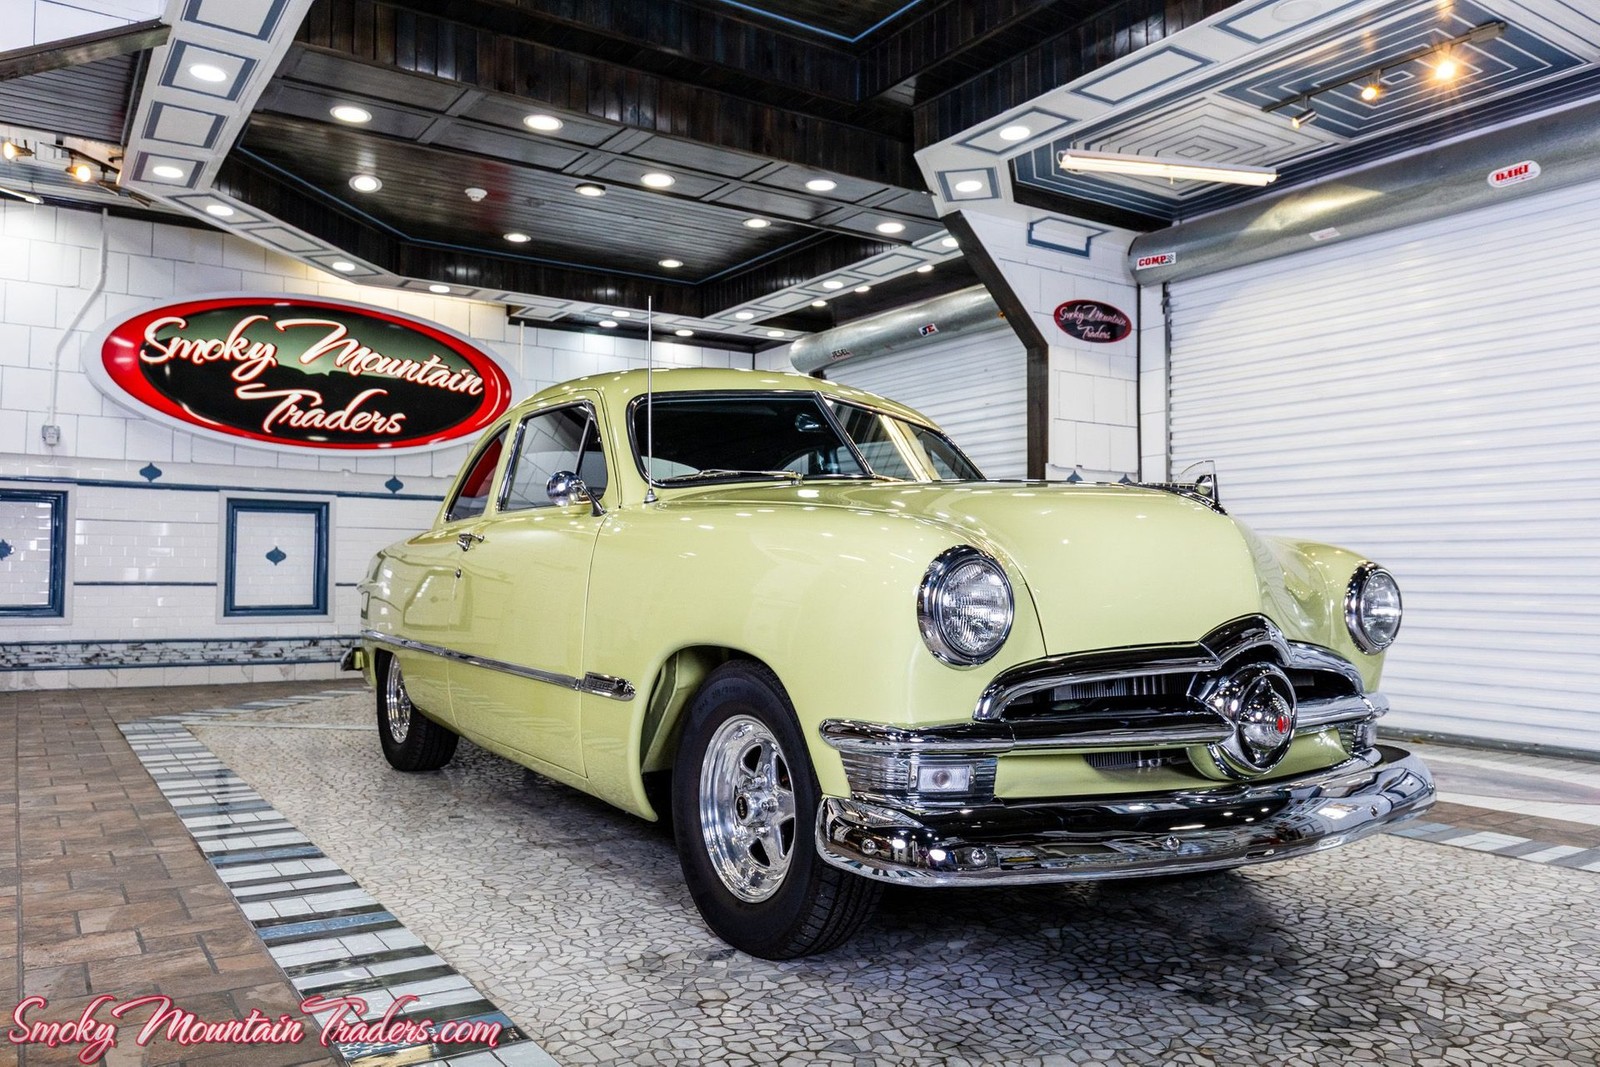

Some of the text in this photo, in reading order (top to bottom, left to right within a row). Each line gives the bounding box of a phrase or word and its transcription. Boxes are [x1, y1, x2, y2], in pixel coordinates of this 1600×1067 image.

[1138, 255, 1168, 266] COMP
[1060, 304, 1128, 327] Smoky Mountain
[1077, 324, 1112, 339] Traders
[139, 315, 485, 396] Smoky Mountain
[235, 382, 407, 434] Traders
